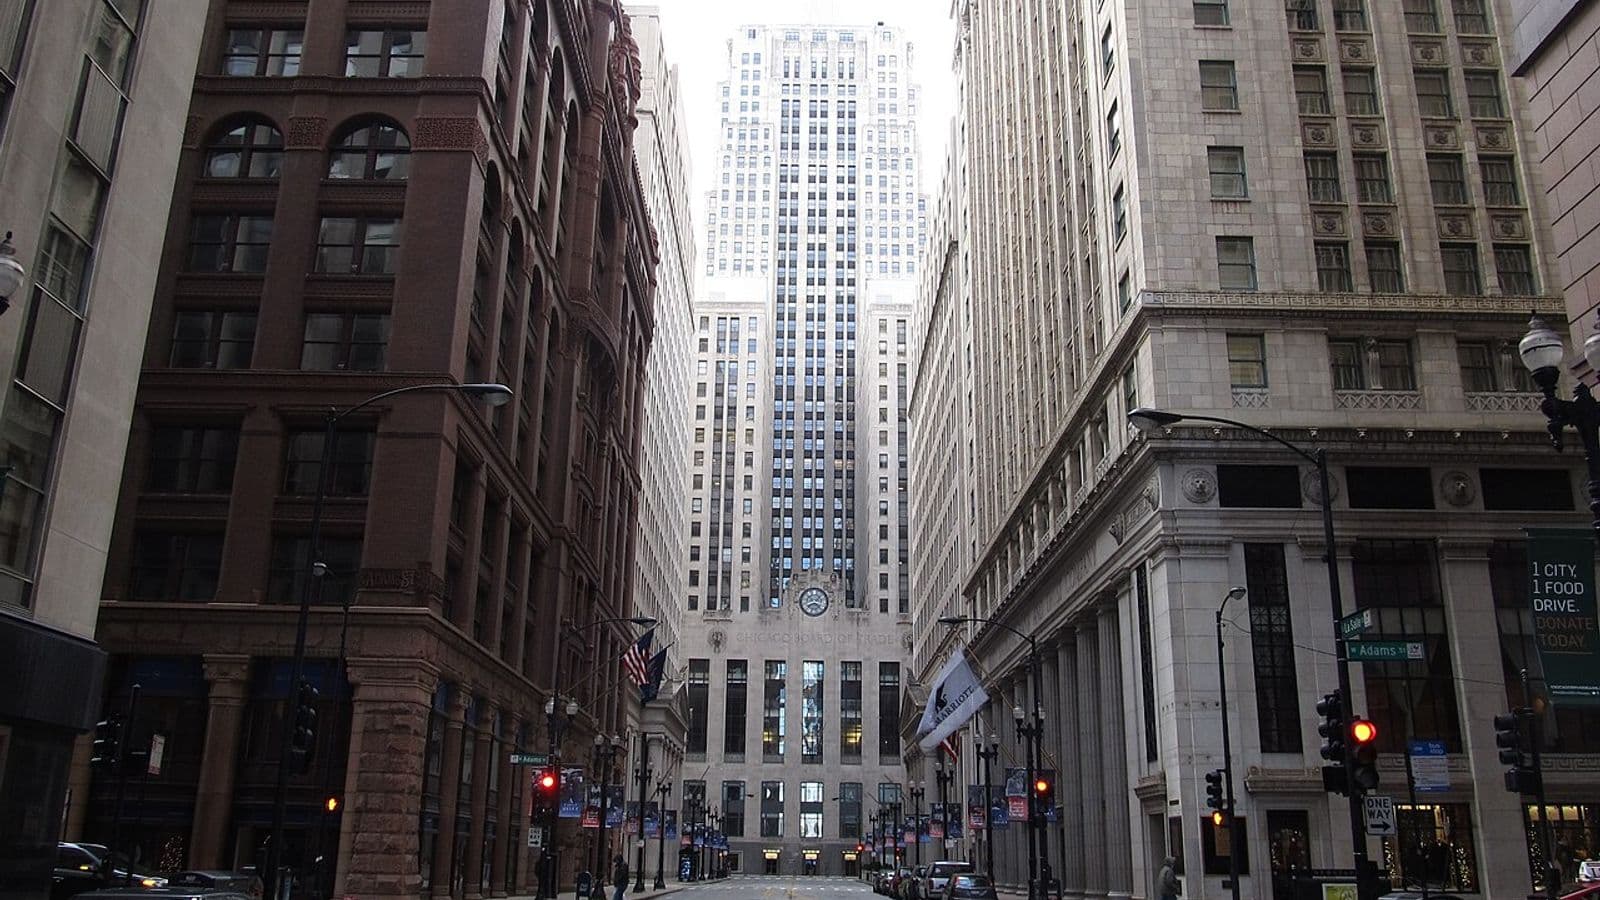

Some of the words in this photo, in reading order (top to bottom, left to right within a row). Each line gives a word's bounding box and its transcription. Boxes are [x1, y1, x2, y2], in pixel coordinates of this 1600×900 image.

[1532, 562, 1539, 576] 1
[1544, 564, 1577, 577] CITY,
[1532, 579, 1539, 594] 1
[1544, 581, 1584, 594] FOOD
[1533, 599, 1580, 613] DRIVE.
[1536, 616, 1593, 630] DONATE
[1541, 634, 1584, 647] TODAY
[1360, 644, 1396, 656] Adams
[1367, 798, 1389, 808] ONE
[1367, 809, 1390, 819] WAY
